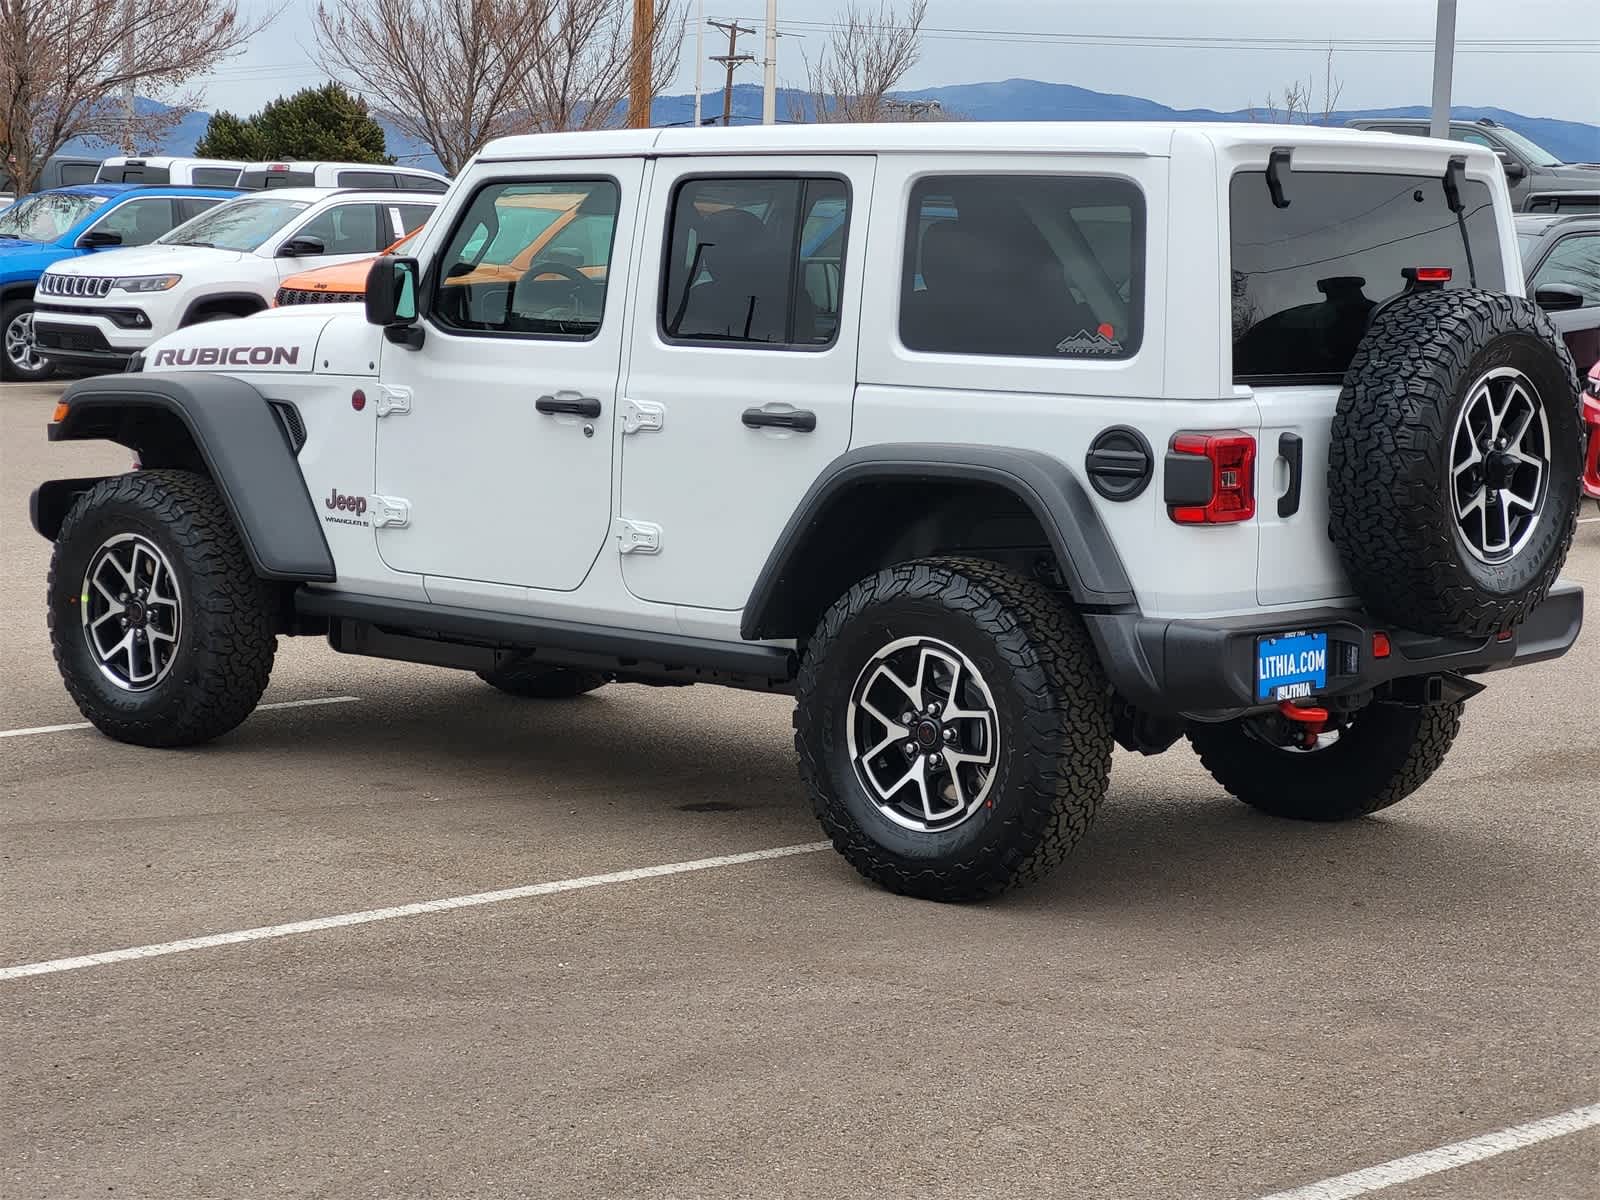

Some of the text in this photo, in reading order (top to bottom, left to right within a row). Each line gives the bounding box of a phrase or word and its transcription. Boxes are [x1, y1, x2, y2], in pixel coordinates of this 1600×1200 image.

[154, 346, 300, 366] RUBICON
[325, 488, 367, 517] Jeep
[1259, 649, 1326, 680] LITHIA.COM
[1285, 682, 1311, 699] LITHIA
